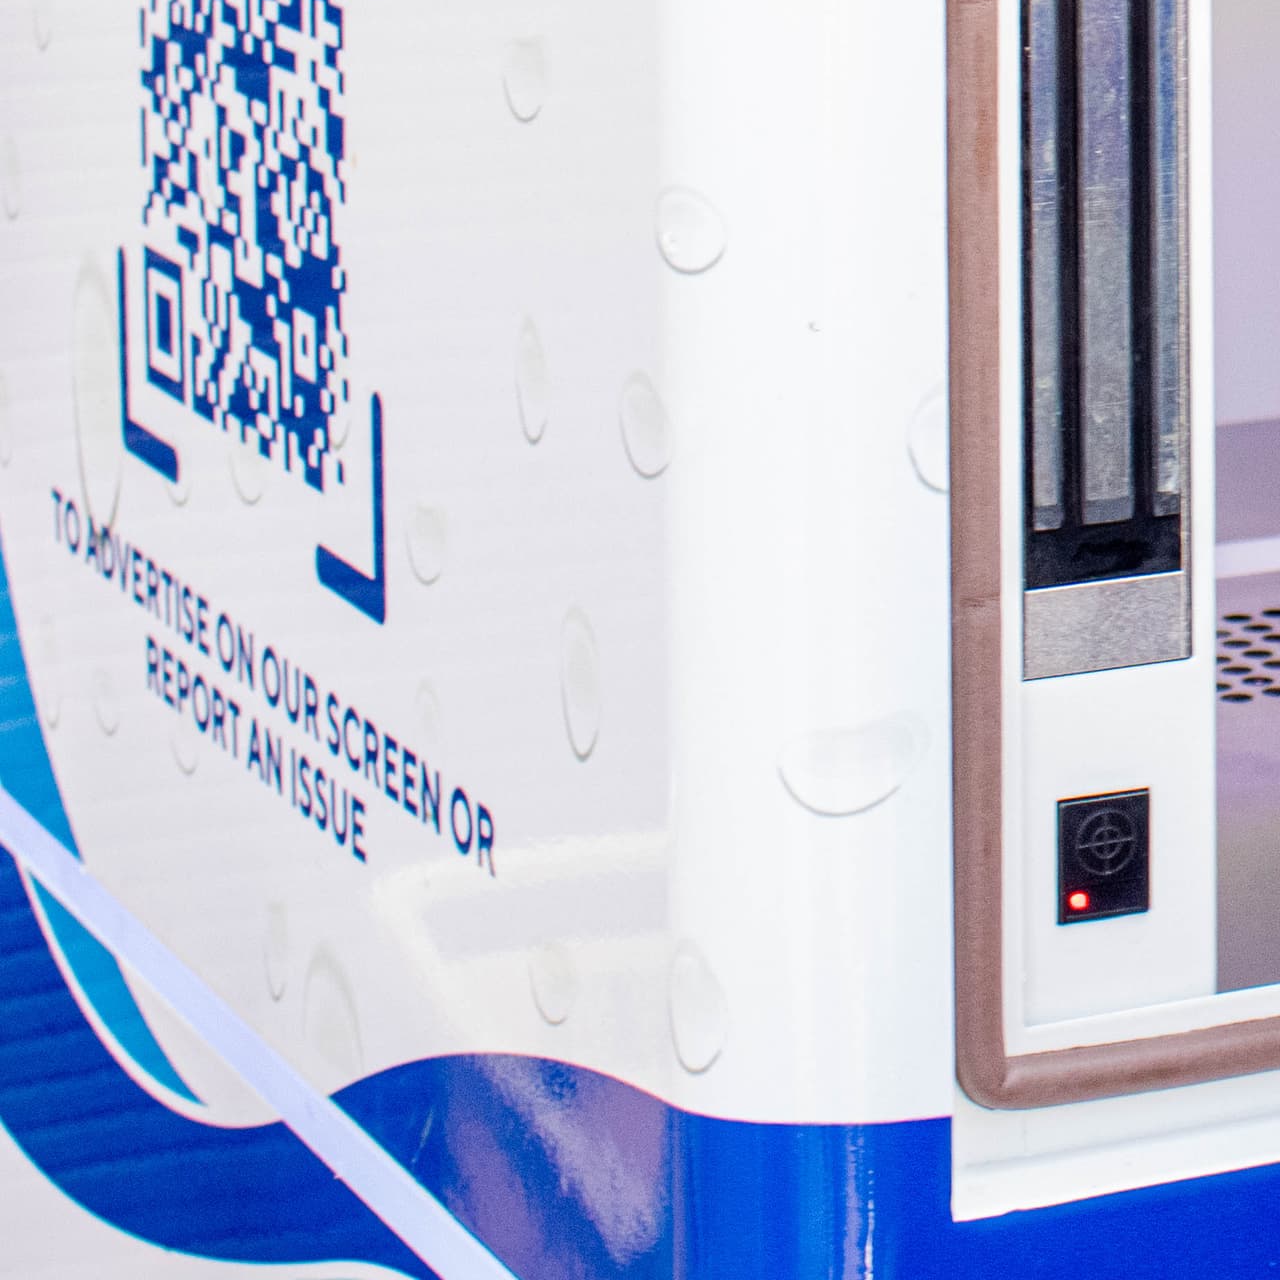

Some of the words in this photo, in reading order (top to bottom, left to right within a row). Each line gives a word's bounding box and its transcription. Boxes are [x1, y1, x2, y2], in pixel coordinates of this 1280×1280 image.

[52, 488, 80, 554] TO
[84, 518, 210, 654] ADVERTISE
[216, 612, 255, 690] ON
[261, 646, 321, 740] OUR
[326, 693, 441, 834] SCREEN
[450, 787, 496, 877] OR
[146, 635, 240, 758] REPORT
[247, 718, 282, 794] AN
[290, 748, 367, 863] ISSUE
